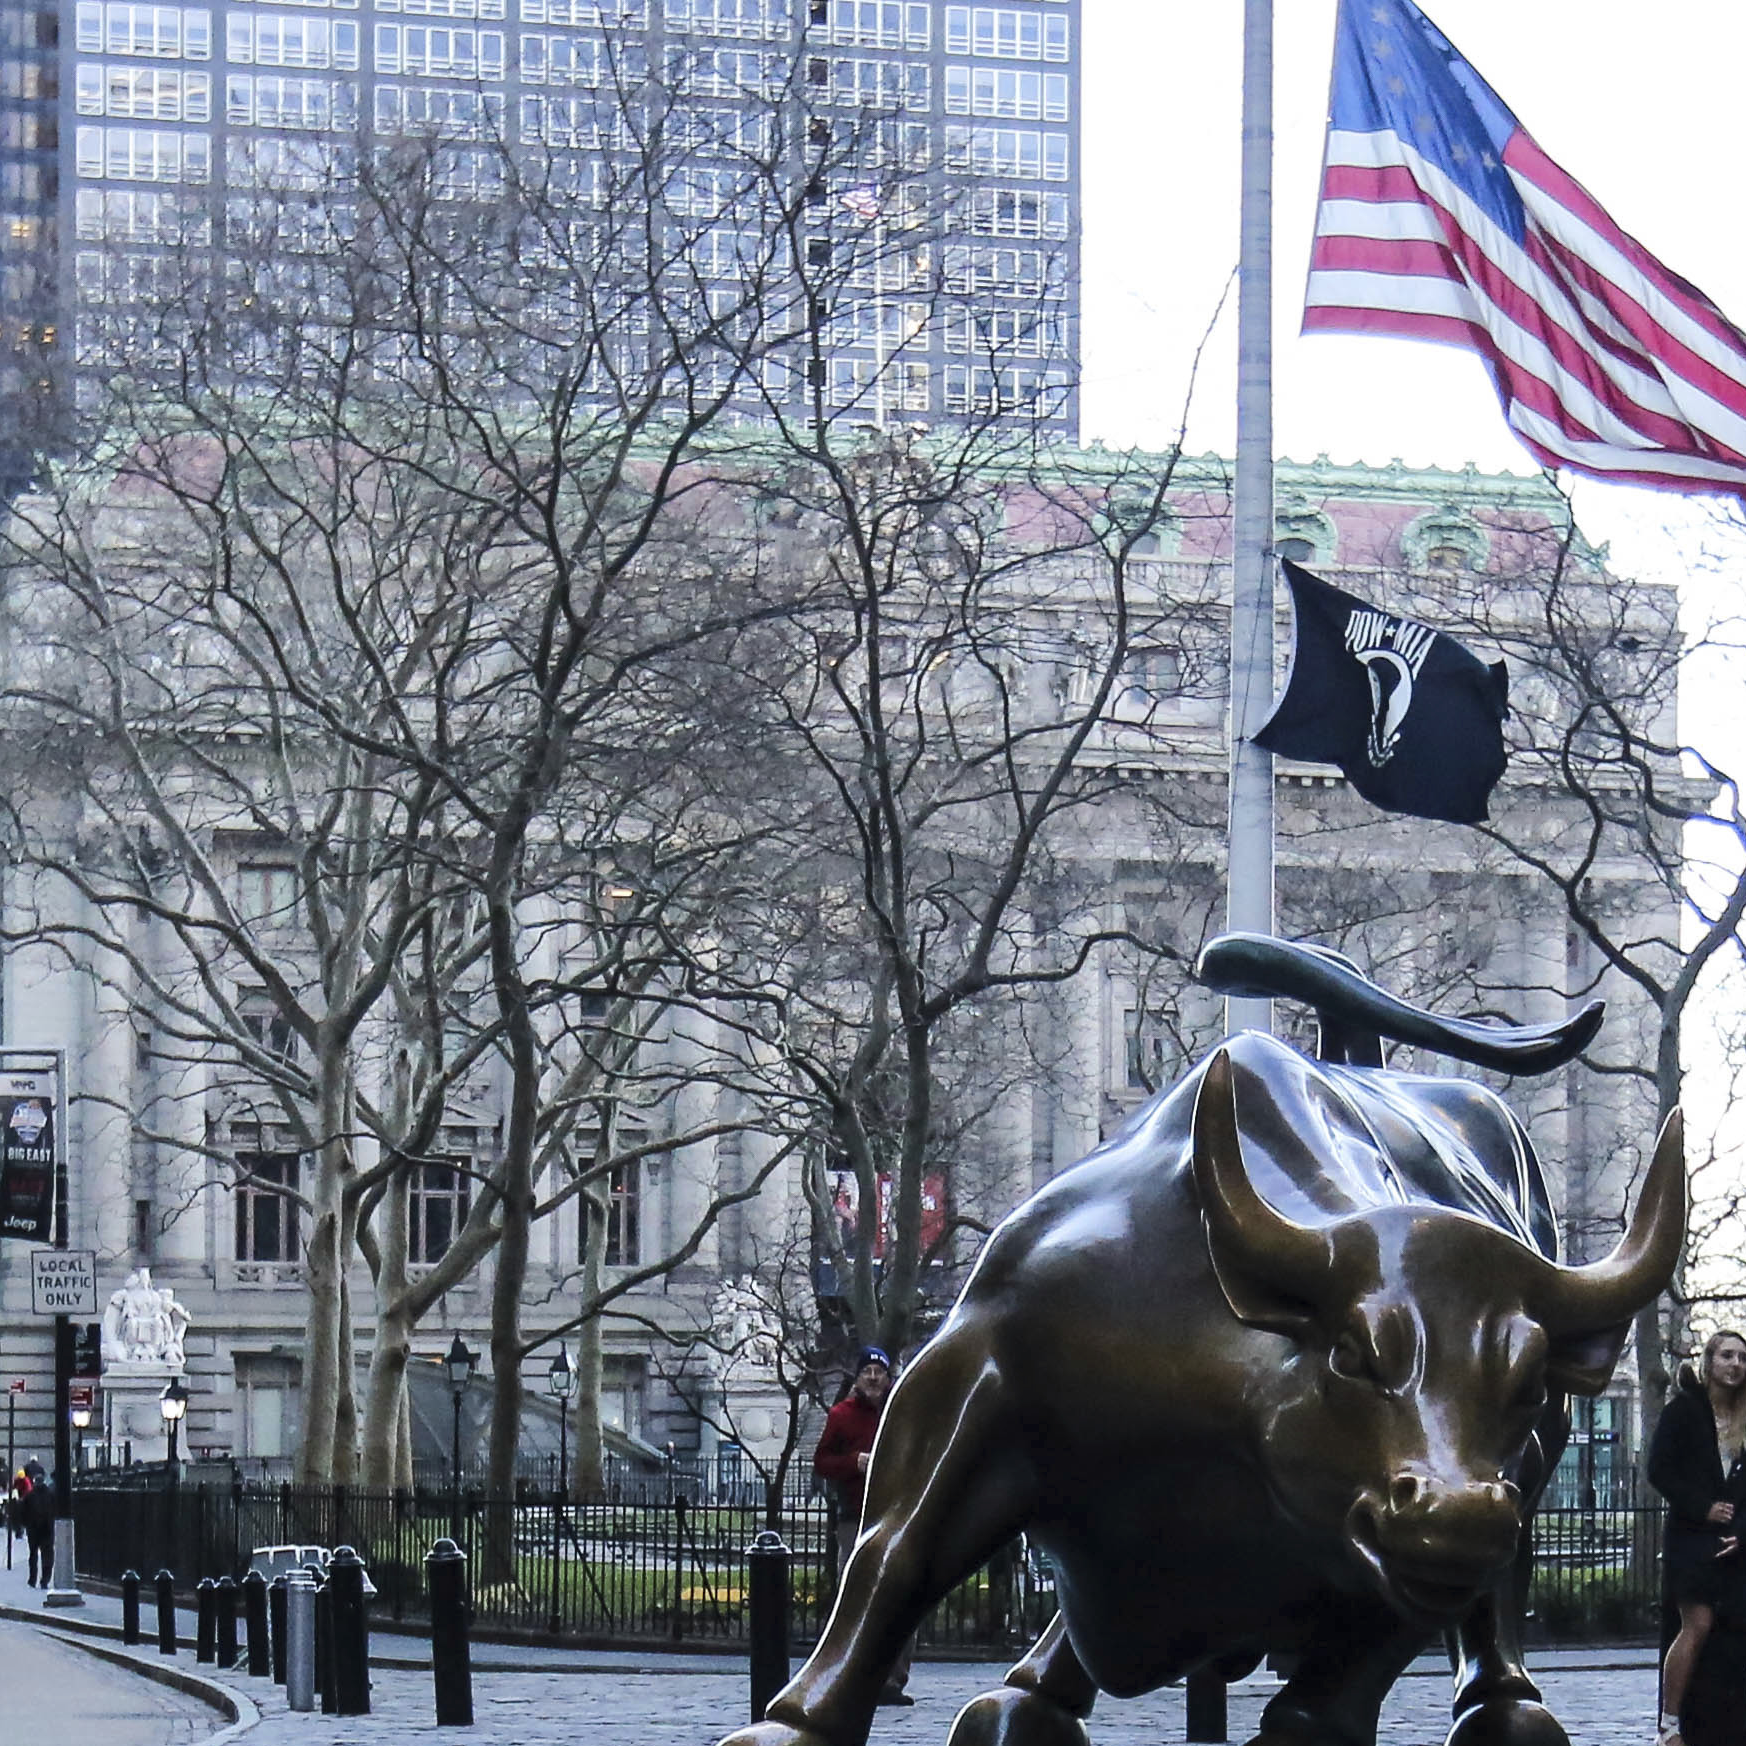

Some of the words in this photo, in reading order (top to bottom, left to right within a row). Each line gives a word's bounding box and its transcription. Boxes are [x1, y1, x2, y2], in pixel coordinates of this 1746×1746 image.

[1345, 610, 1389, 653] POW
[1392, 620, 1438, 682] MIA
[8, 1147, 25, 1160] BIG
[27, 1148, 51, 1162] EAST
[4, 1214, 37, 1231] Jeep
[39, 1260, 86, 1273] LOCAL
[37, 1275, 91, 1289] TRAFFIC
[45, 1292, 82, 1306] ONLY
